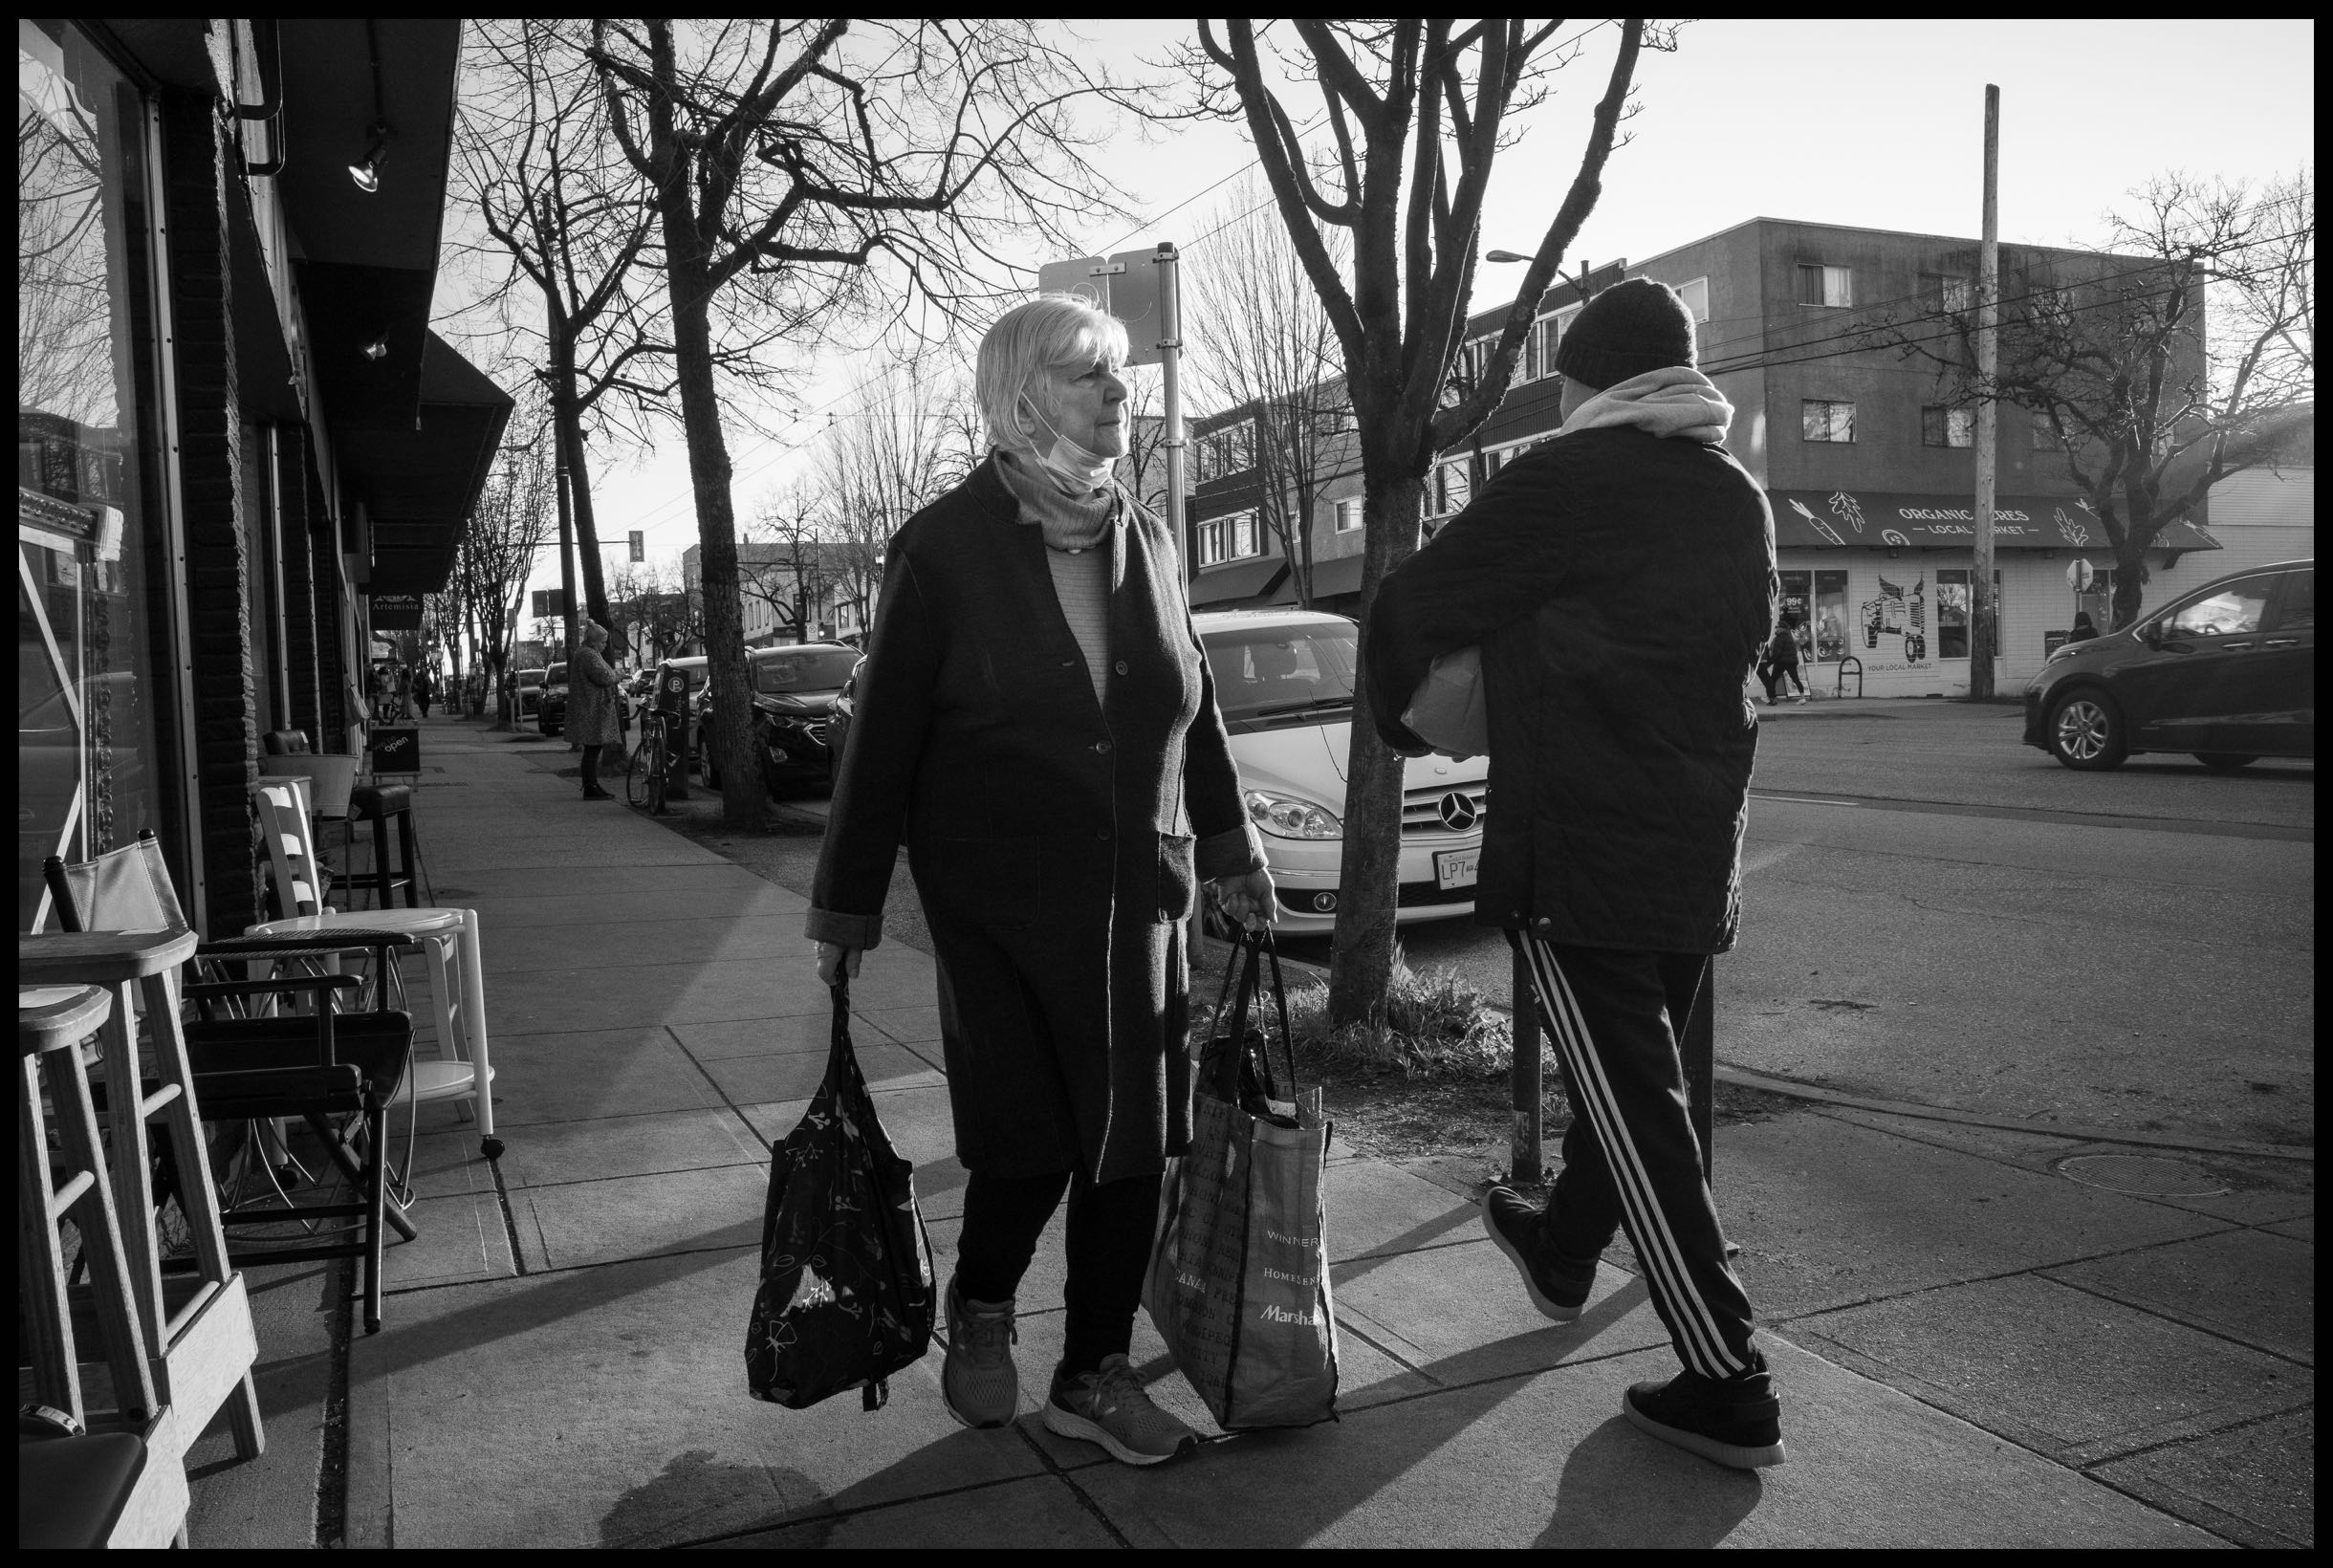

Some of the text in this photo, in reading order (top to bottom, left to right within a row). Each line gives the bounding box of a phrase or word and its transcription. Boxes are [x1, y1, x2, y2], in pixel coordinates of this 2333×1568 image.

[1898, 508, 2030, 521] ORGANIC RES
[1928, 525, 1973, 534] LOCAL
[372, 602, 419, 611] Artemisia
[384, 736, 409, 752] open
[1441, 860, 1466, 881] LP7
